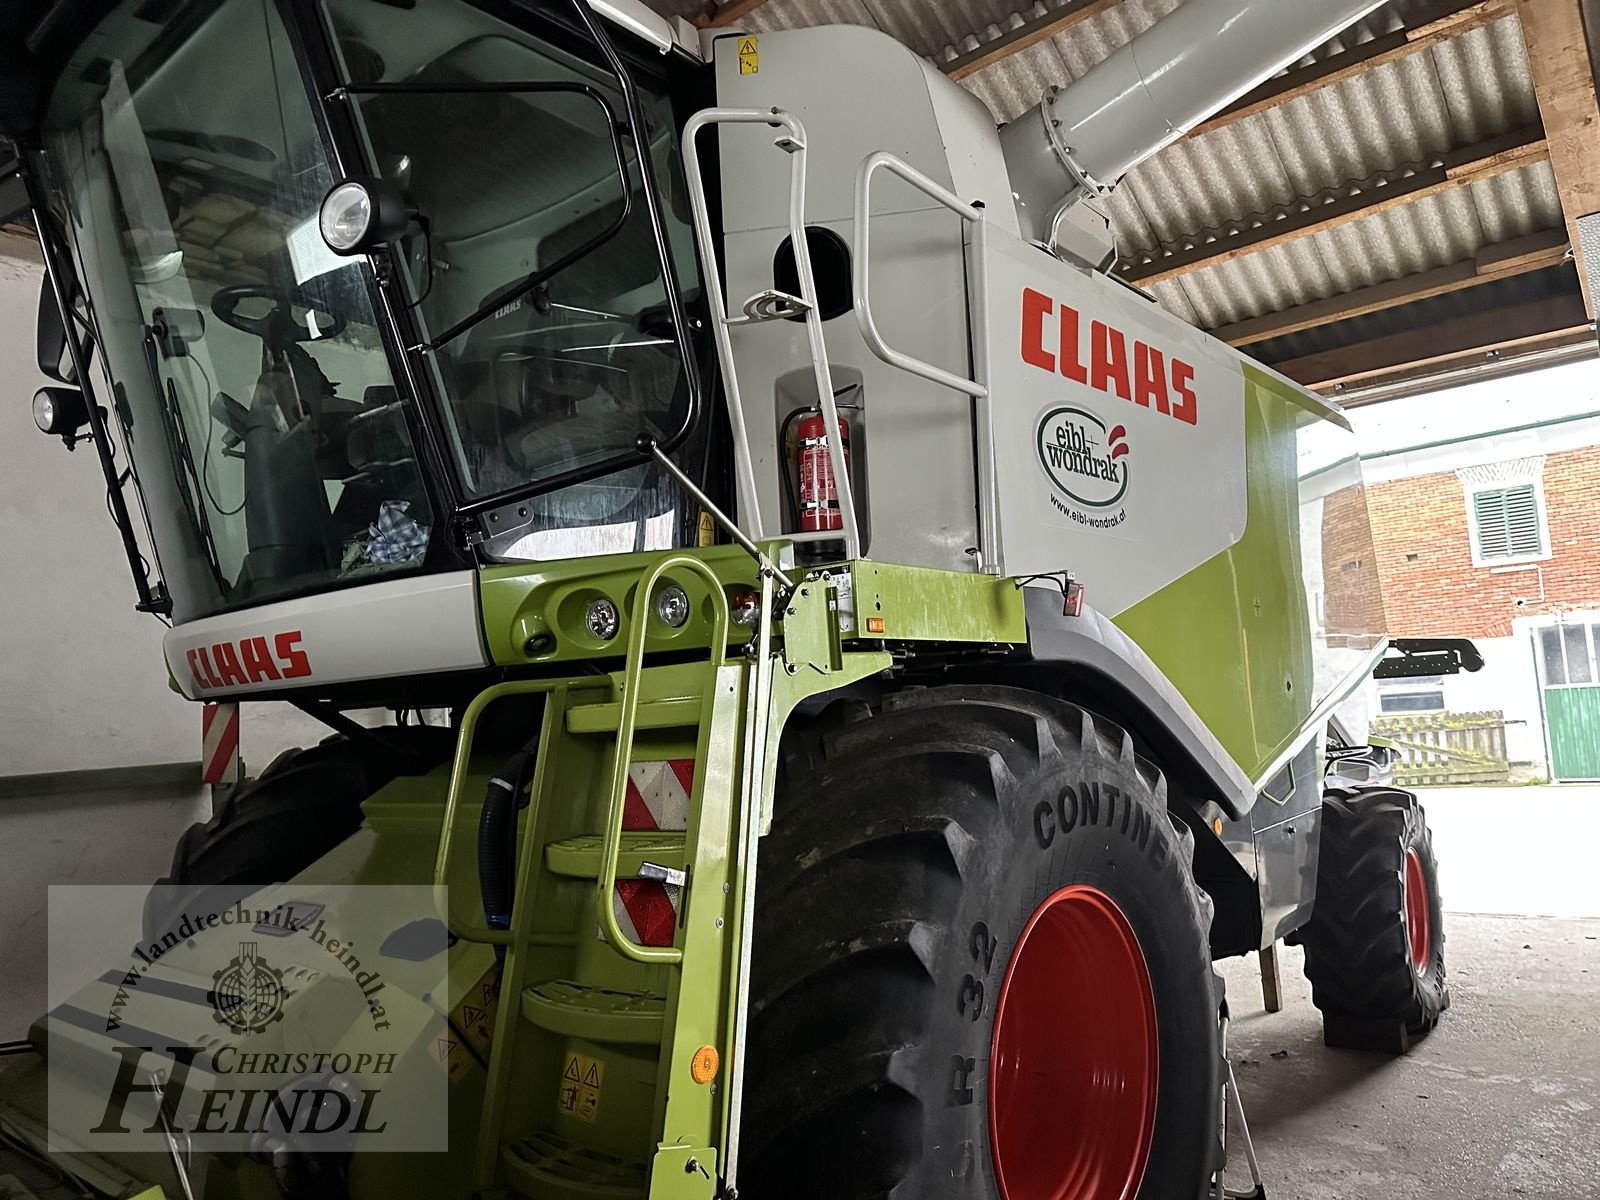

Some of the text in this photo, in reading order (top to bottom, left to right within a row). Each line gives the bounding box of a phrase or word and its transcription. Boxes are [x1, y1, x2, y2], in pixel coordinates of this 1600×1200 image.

[1021, 287, 1197, 426] CLAAS
[1046, 445, 1119, 483] wondrak
[1050, 493, 1127, 529] www.eibl-wondrak.at
[186, 630, 312, 689] CLAAS
